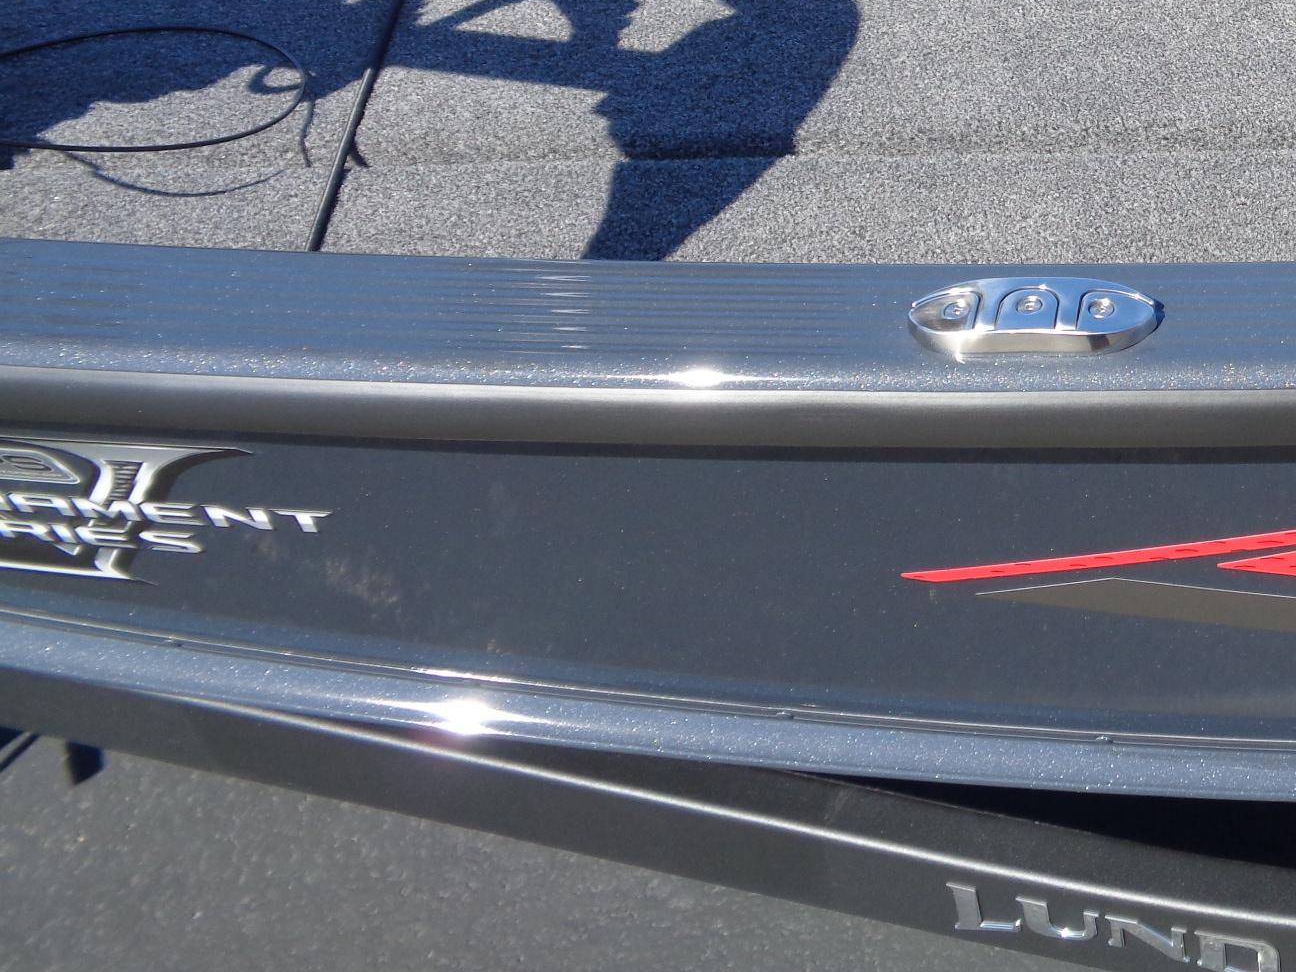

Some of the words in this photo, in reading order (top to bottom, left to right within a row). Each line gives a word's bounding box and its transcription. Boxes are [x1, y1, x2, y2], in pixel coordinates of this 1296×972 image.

[0, 491, 334, 533] AMENT
[0, 519, 205, 554] RIES
[945, 881, 1281, 972] LUND
